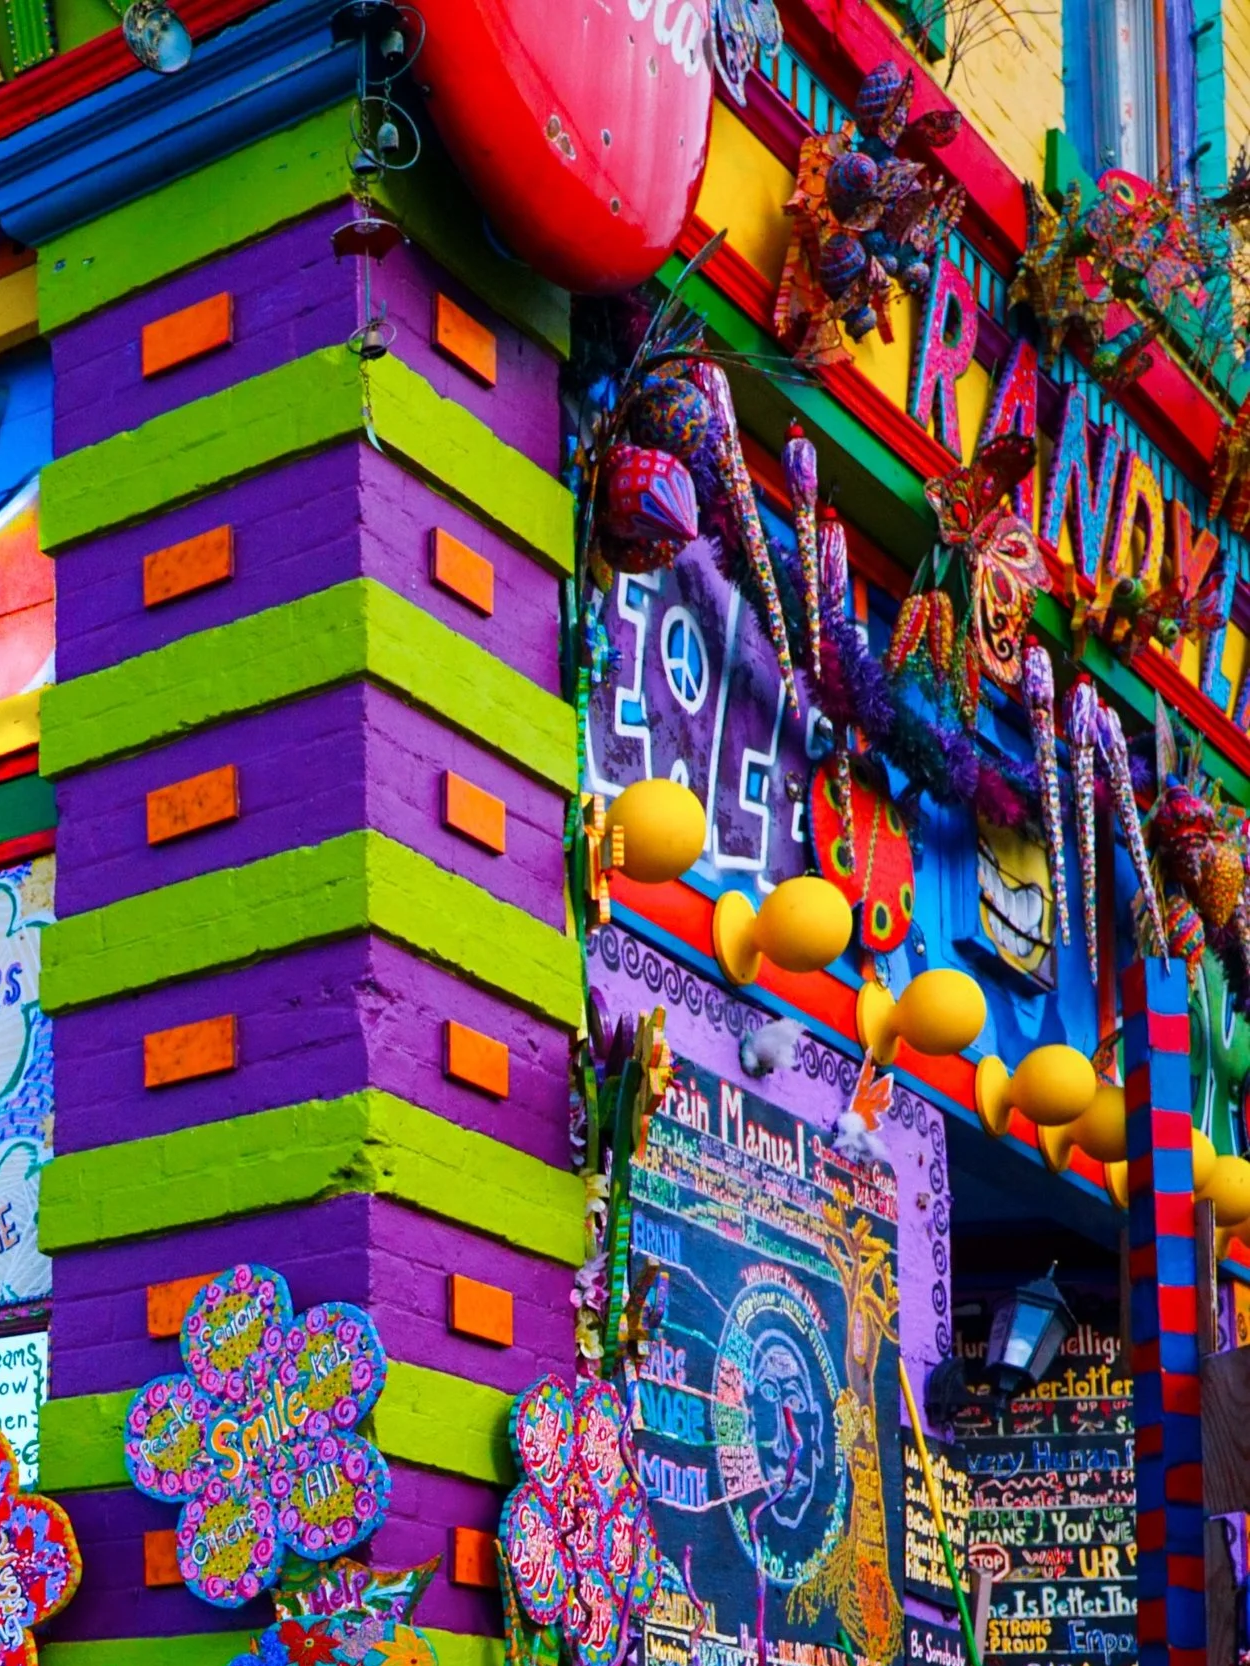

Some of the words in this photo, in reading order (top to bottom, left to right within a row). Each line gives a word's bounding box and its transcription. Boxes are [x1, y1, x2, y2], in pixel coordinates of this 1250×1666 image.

[721, 1080, 805, 1178] Manual
[633, 1210, 682, 1266] BRAIN
[210, 1378, 311, 1481] Smile
[636, 1446, 709, 1505] MOUTH
[1033, 1440, 1120, 1472] Human
[304, 1462, 341, 1508] All
[190, 1508, 258, 1566] Others
[969, 1553, 1004, 1572] STOP
[1013, 1589, 1038, 1619] Is
[1042, 1586, 1105, 1618] Better
[910, 1628, 924, 1658] Be
[988, 1619, 1052, 1637] STRONG
[989, 1637, 1048, 1654] PROUD
